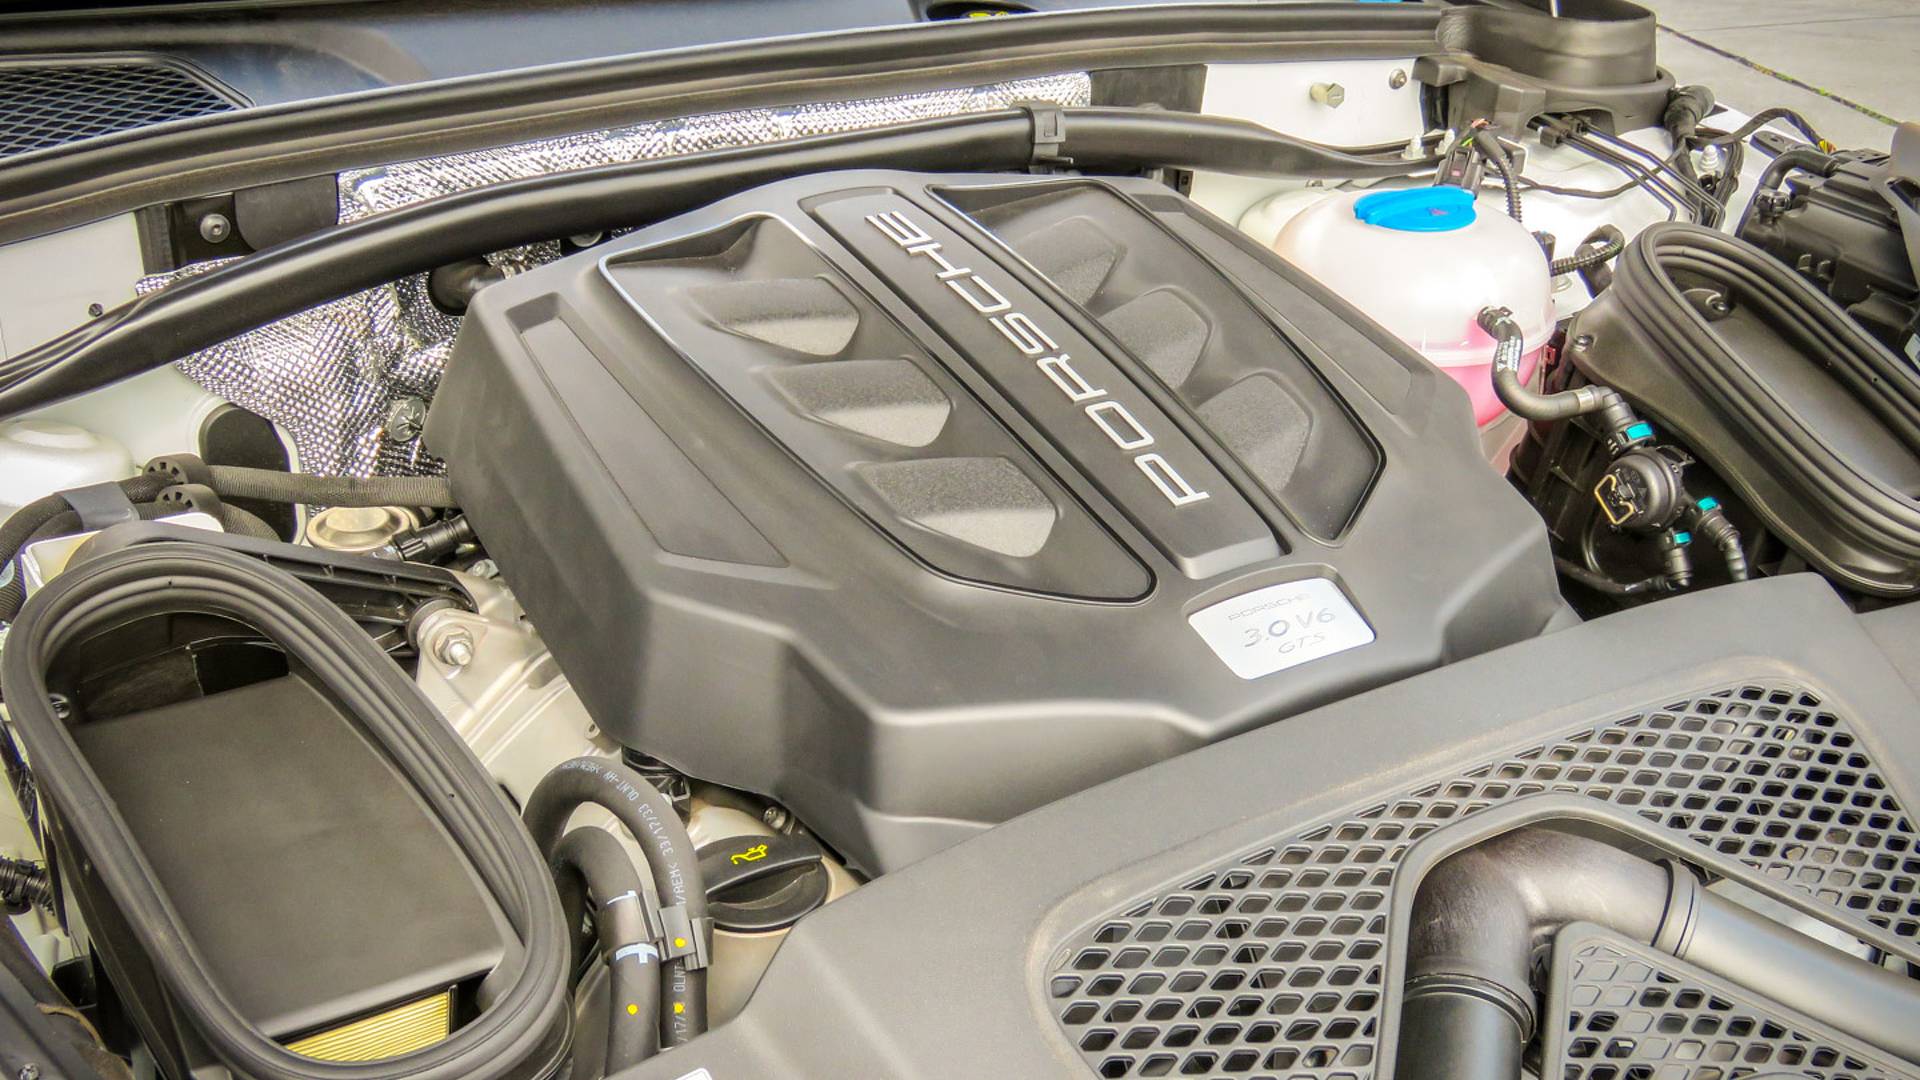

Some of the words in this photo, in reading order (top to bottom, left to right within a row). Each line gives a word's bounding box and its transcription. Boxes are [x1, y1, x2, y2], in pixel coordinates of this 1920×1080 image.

[864, 210, 1211, 508] PORSCHE
[1244, 619, 1291, 648] 3.0
[1295, 607, 1336, 629] V6
[1278, 632, 1326, 654] GTS
